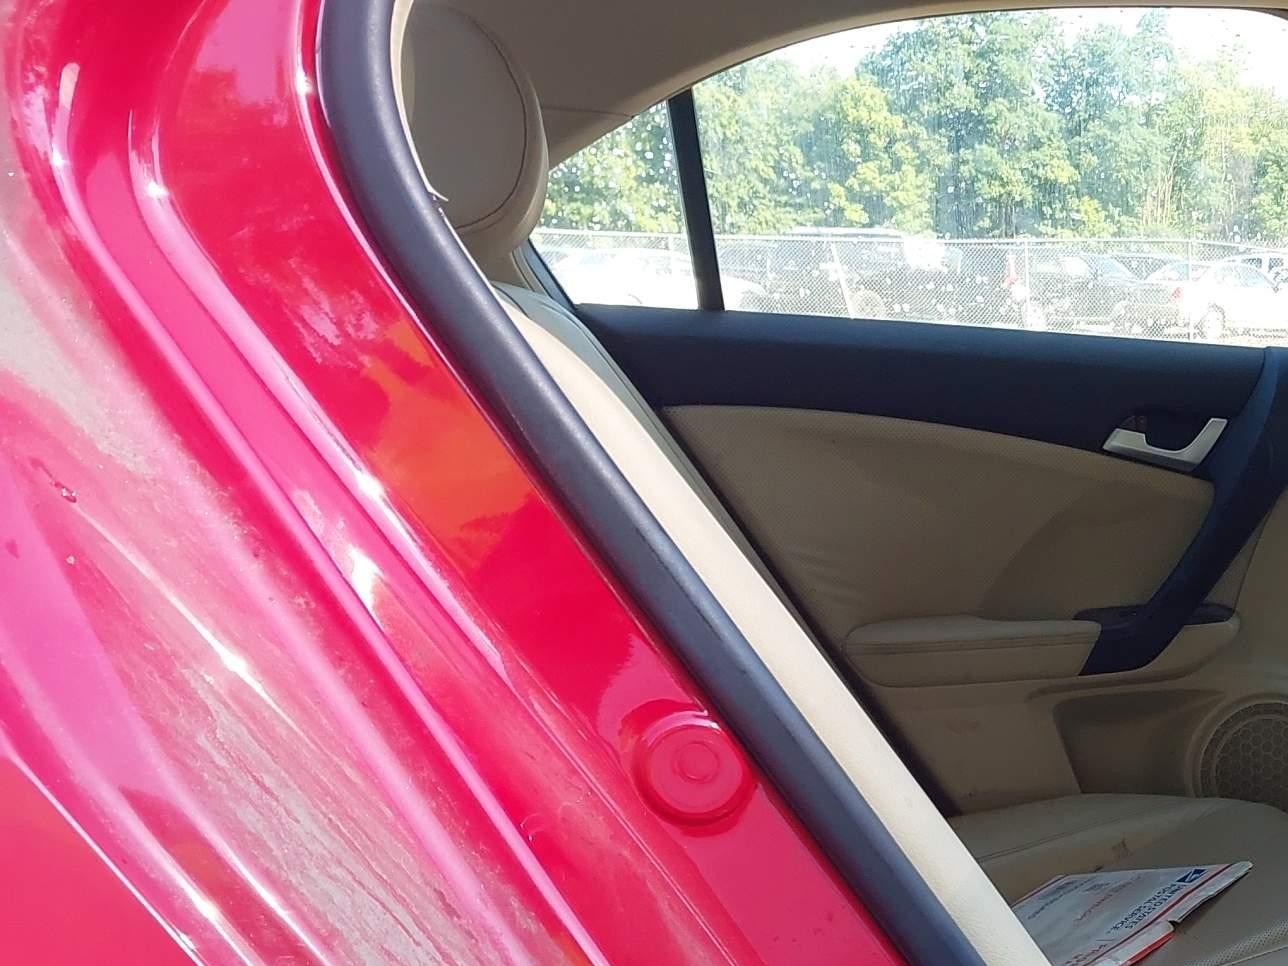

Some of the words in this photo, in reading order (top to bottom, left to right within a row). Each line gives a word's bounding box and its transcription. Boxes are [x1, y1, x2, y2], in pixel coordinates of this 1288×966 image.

[1143, 883, 1177, 905] POSTAL
[1154, 883, 1187, 907] UNITED
[1124, 905, 1157, 929] STATES
